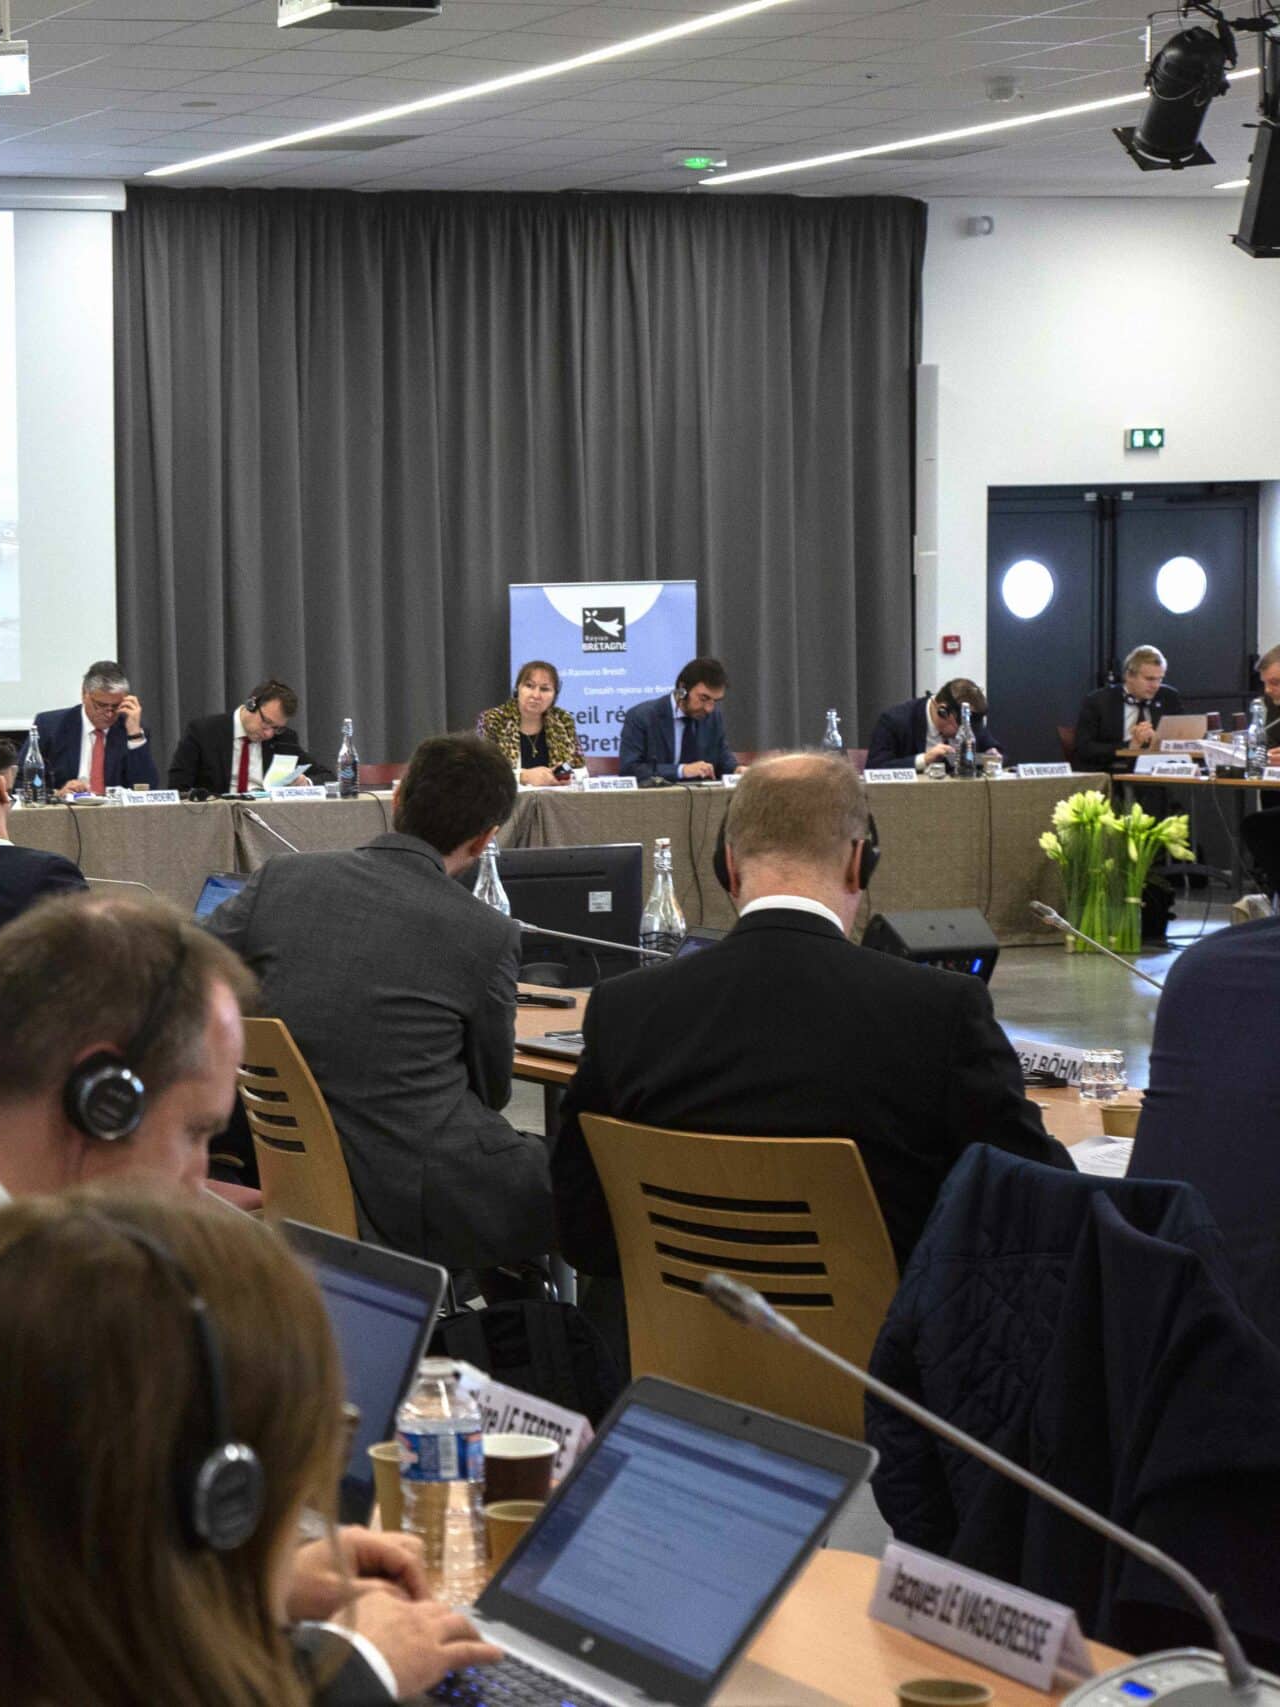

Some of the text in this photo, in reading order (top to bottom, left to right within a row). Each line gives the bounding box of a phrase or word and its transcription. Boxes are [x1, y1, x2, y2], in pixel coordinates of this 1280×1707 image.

[582, 642, 628, 651] BRETAGNE
[576, 706, 600, 724] eil
[939, 1582, 962, 1625] LE
